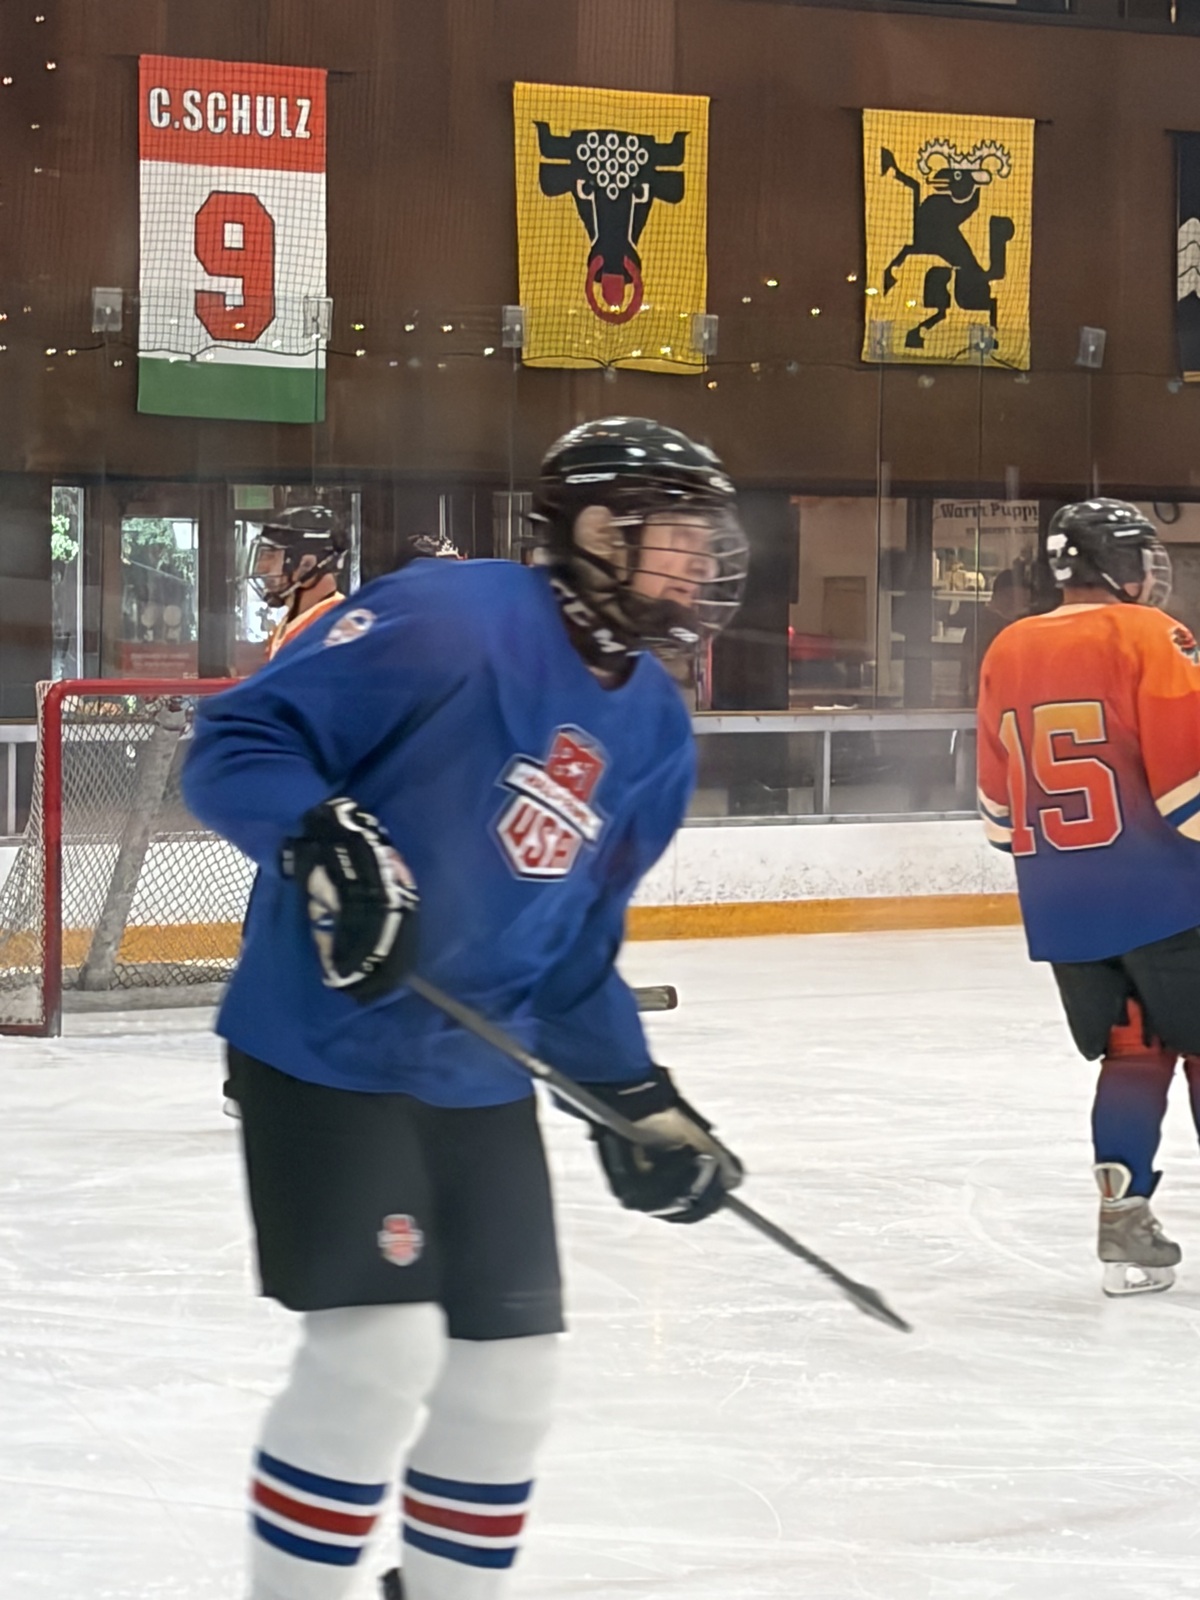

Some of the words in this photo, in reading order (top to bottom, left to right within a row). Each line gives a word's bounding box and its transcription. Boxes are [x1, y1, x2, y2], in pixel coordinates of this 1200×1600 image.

[149, 86, 312, 139] C.SCHULZ
[194, 190, 276, 343] 9
[940, 503, 987, 518] Warm
[999, 701, 1123, 856] 15
